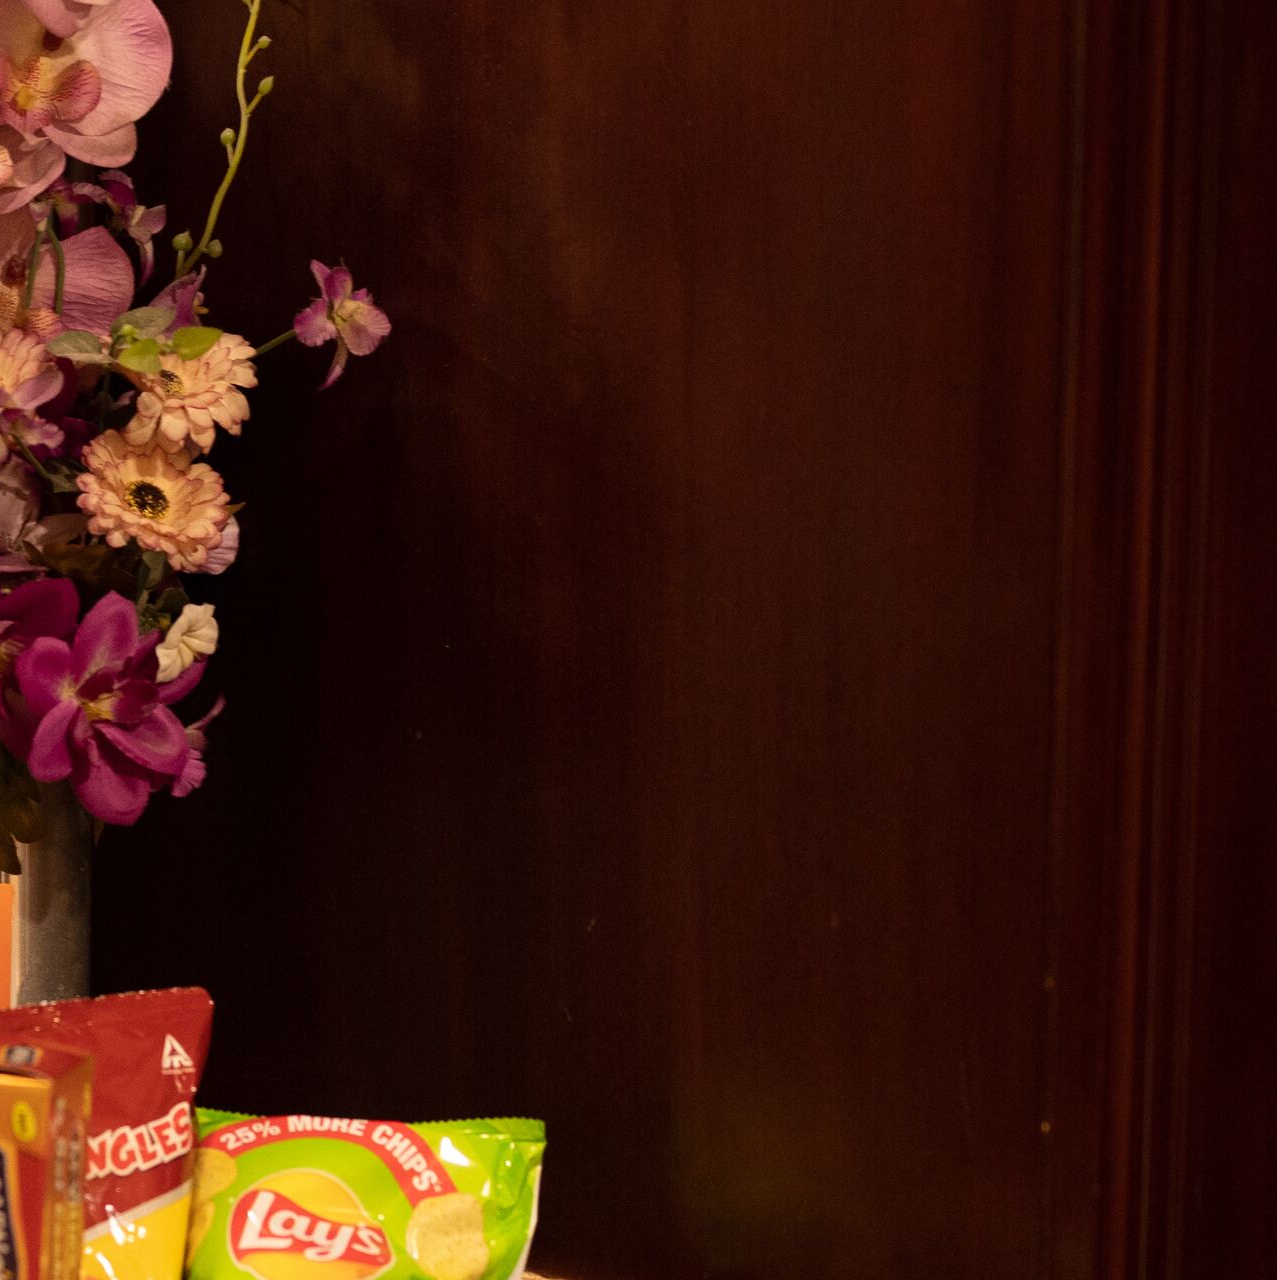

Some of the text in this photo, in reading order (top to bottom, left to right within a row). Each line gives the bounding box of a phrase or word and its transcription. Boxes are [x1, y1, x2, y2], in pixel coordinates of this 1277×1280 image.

[220, 1115, 438, 1192] 25% MORE CHIPS
[239, 1191, 384, 1261] Lay's
